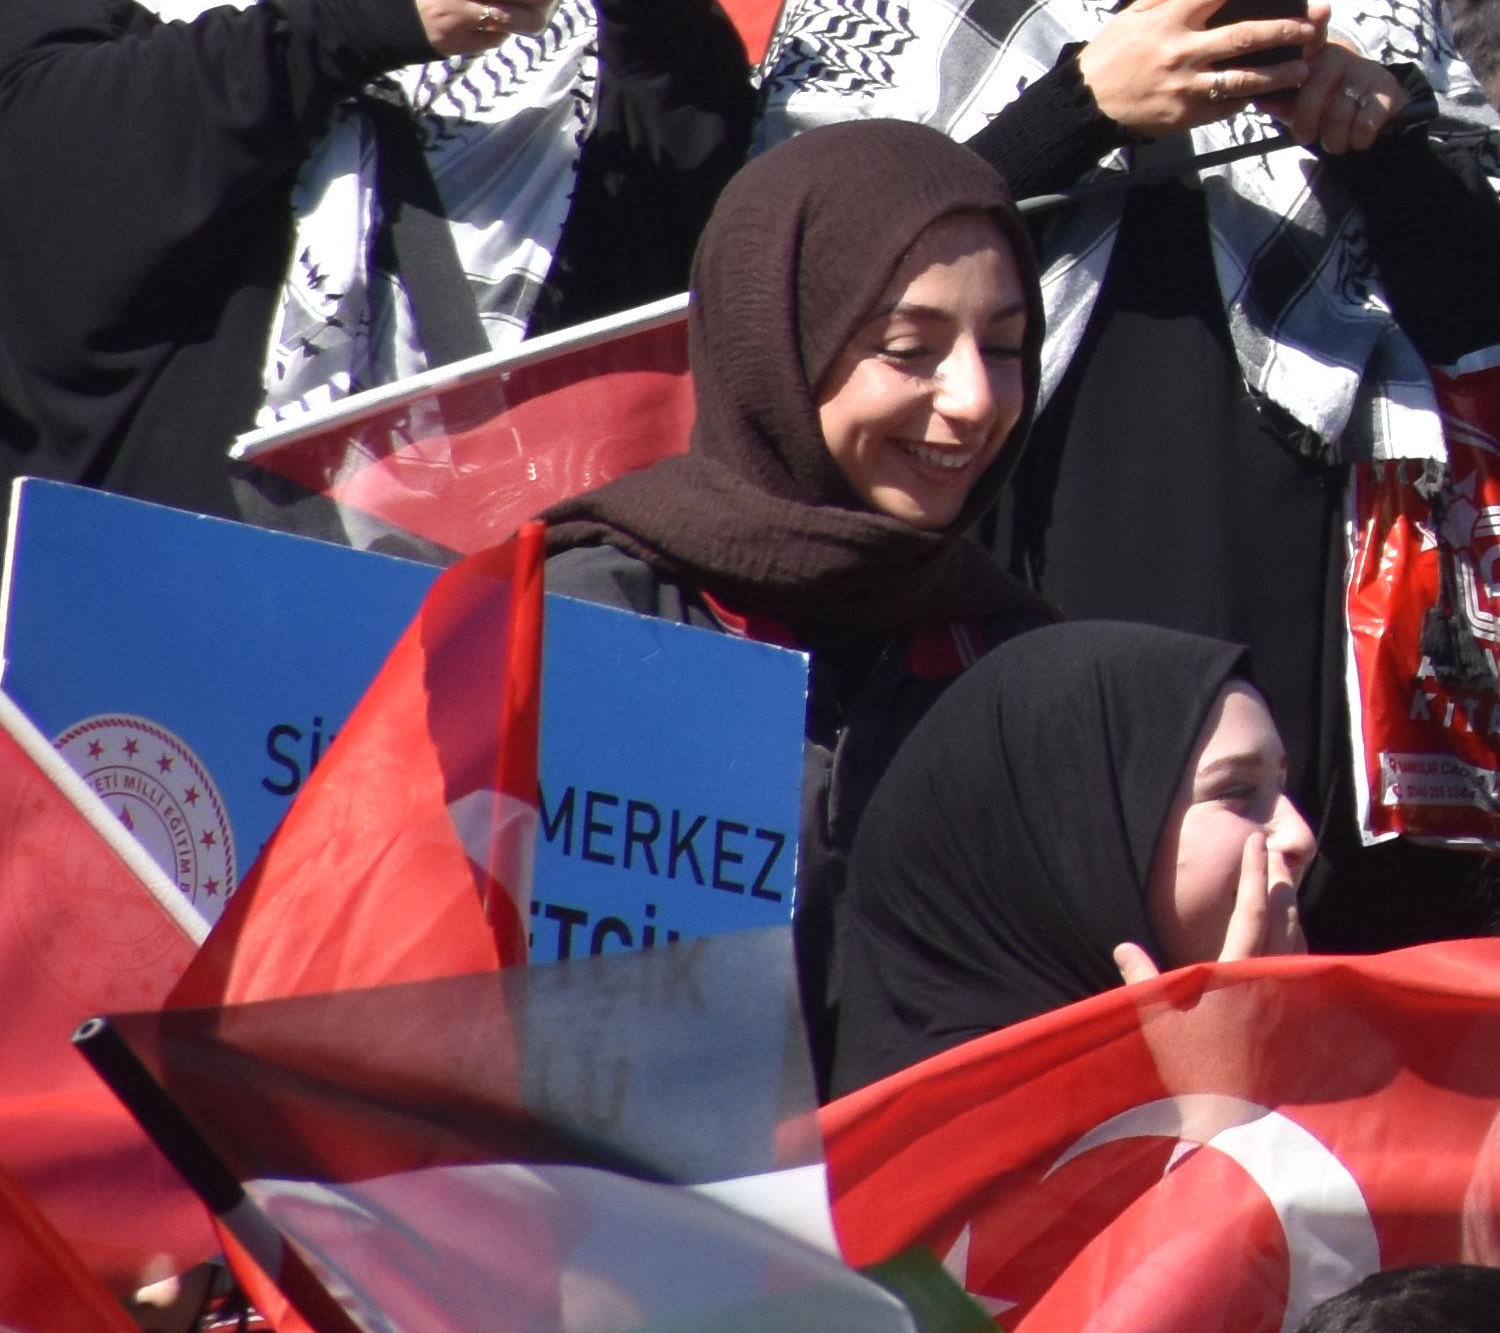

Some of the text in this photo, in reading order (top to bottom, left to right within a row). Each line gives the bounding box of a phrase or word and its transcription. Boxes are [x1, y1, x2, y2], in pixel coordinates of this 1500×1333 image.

[123, 775, 191, 874] MİLLİ EĞİTİM
[538, 780, 786, 903] MERKEZ
